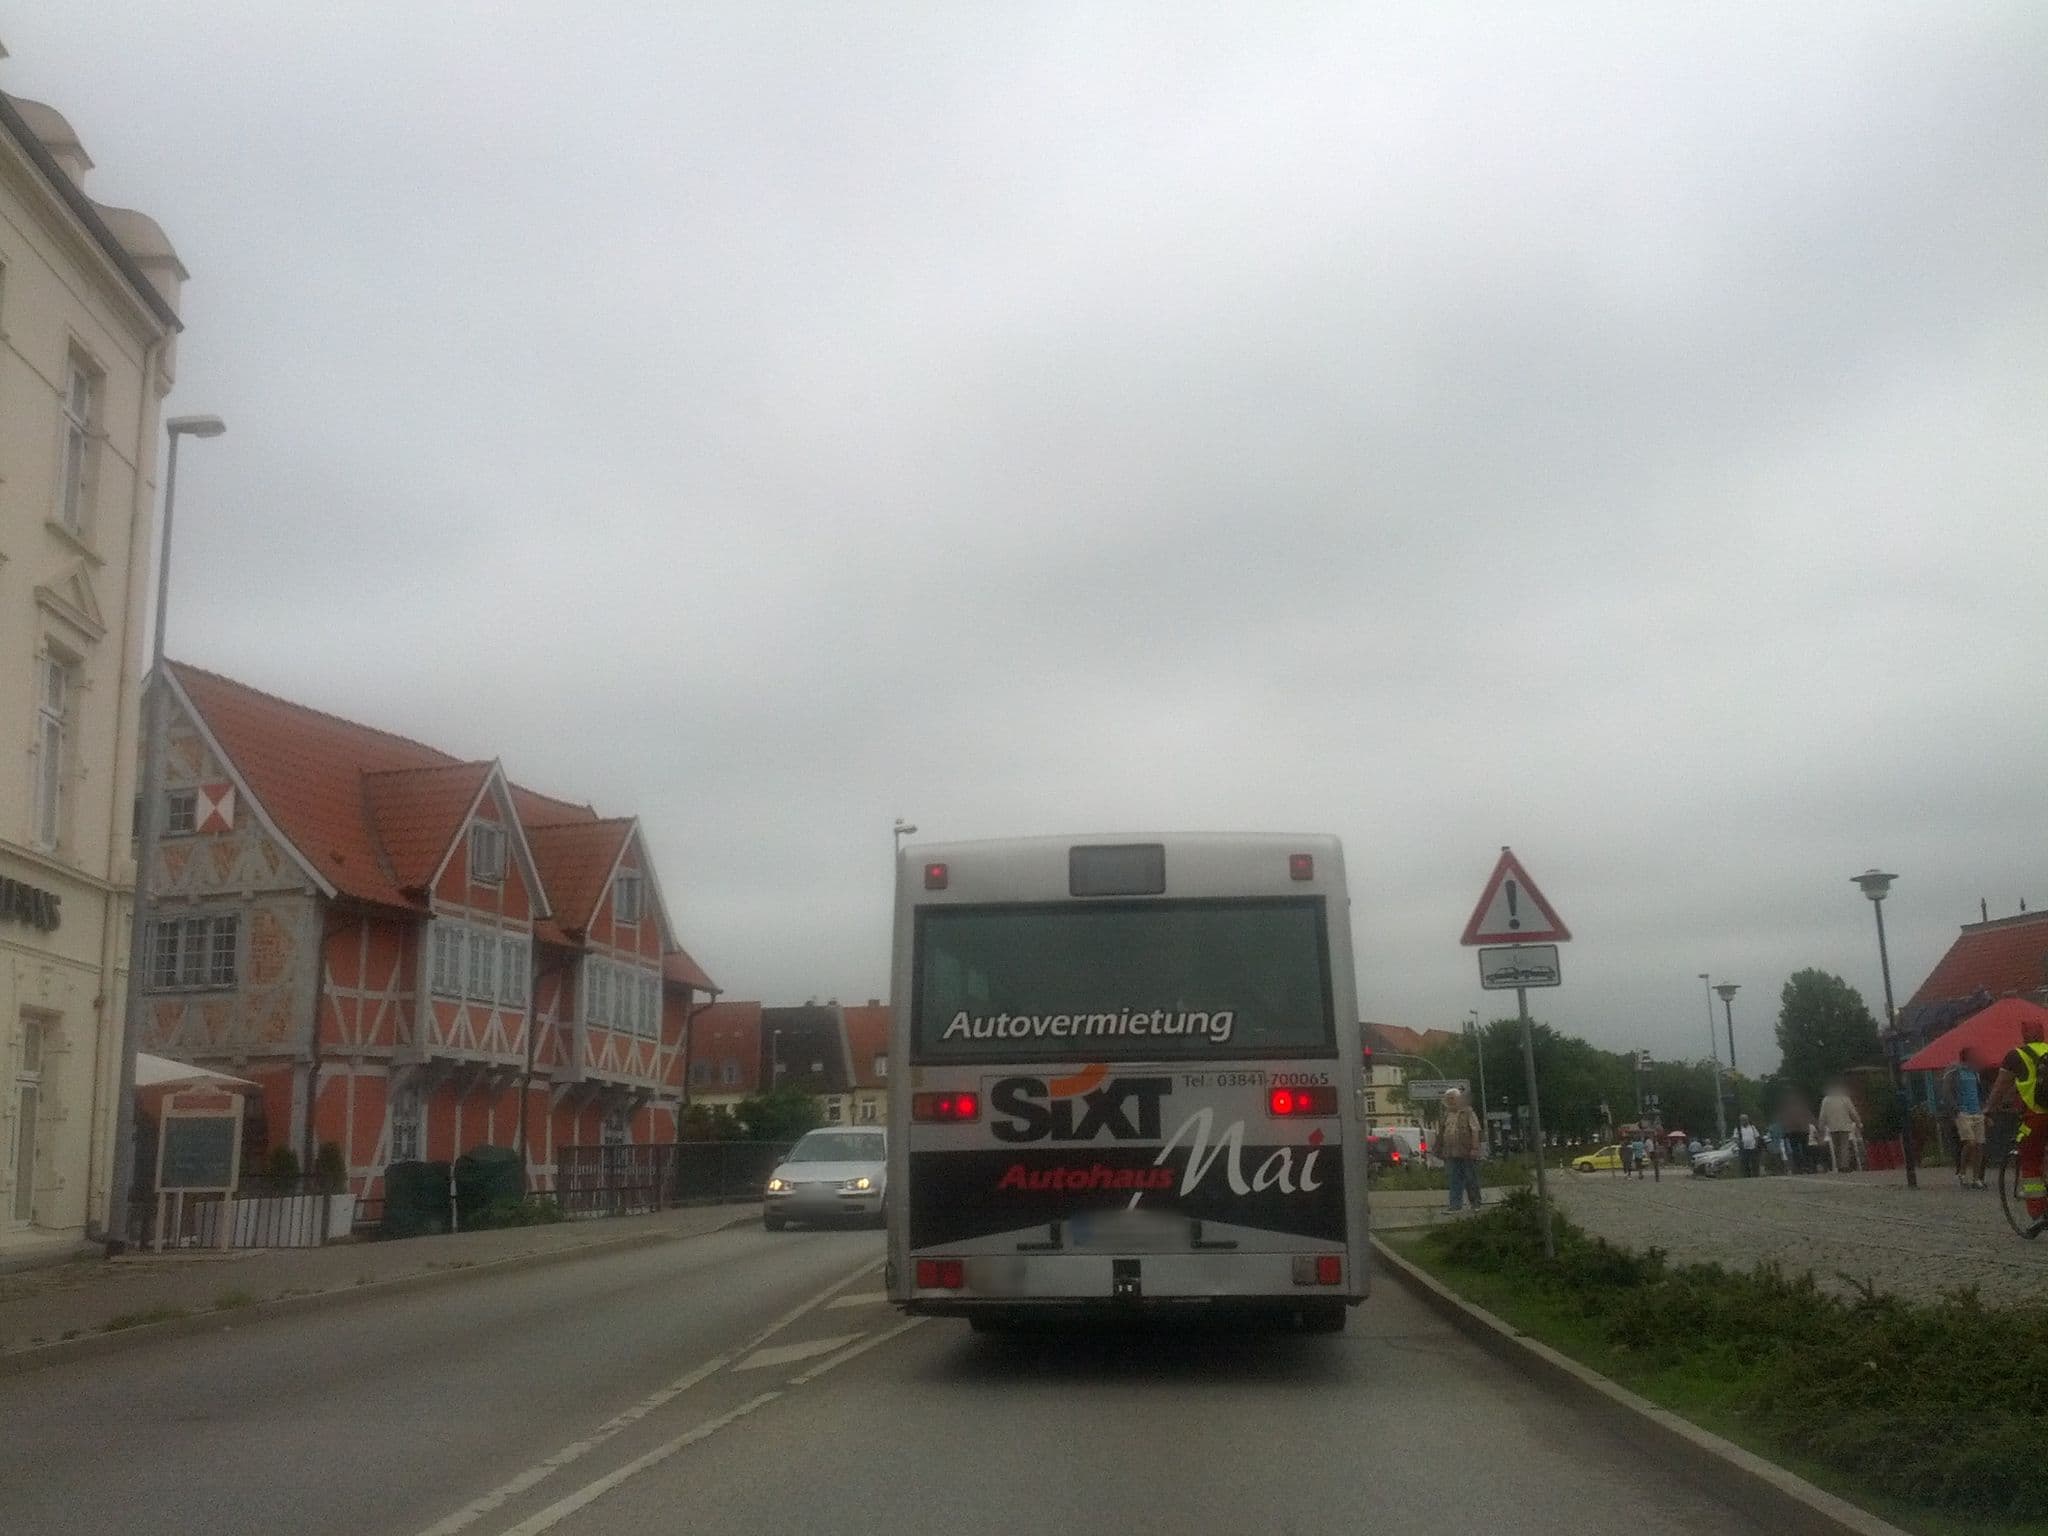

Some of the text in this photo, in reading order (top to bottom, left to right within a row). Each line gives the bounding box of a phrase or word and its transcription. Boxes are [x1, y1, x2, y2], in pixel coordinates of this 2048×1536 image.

[943, 1007, 1233, 1041] Autovermietung
[998, 1106, 1323, 1197] Autohaus Mai
